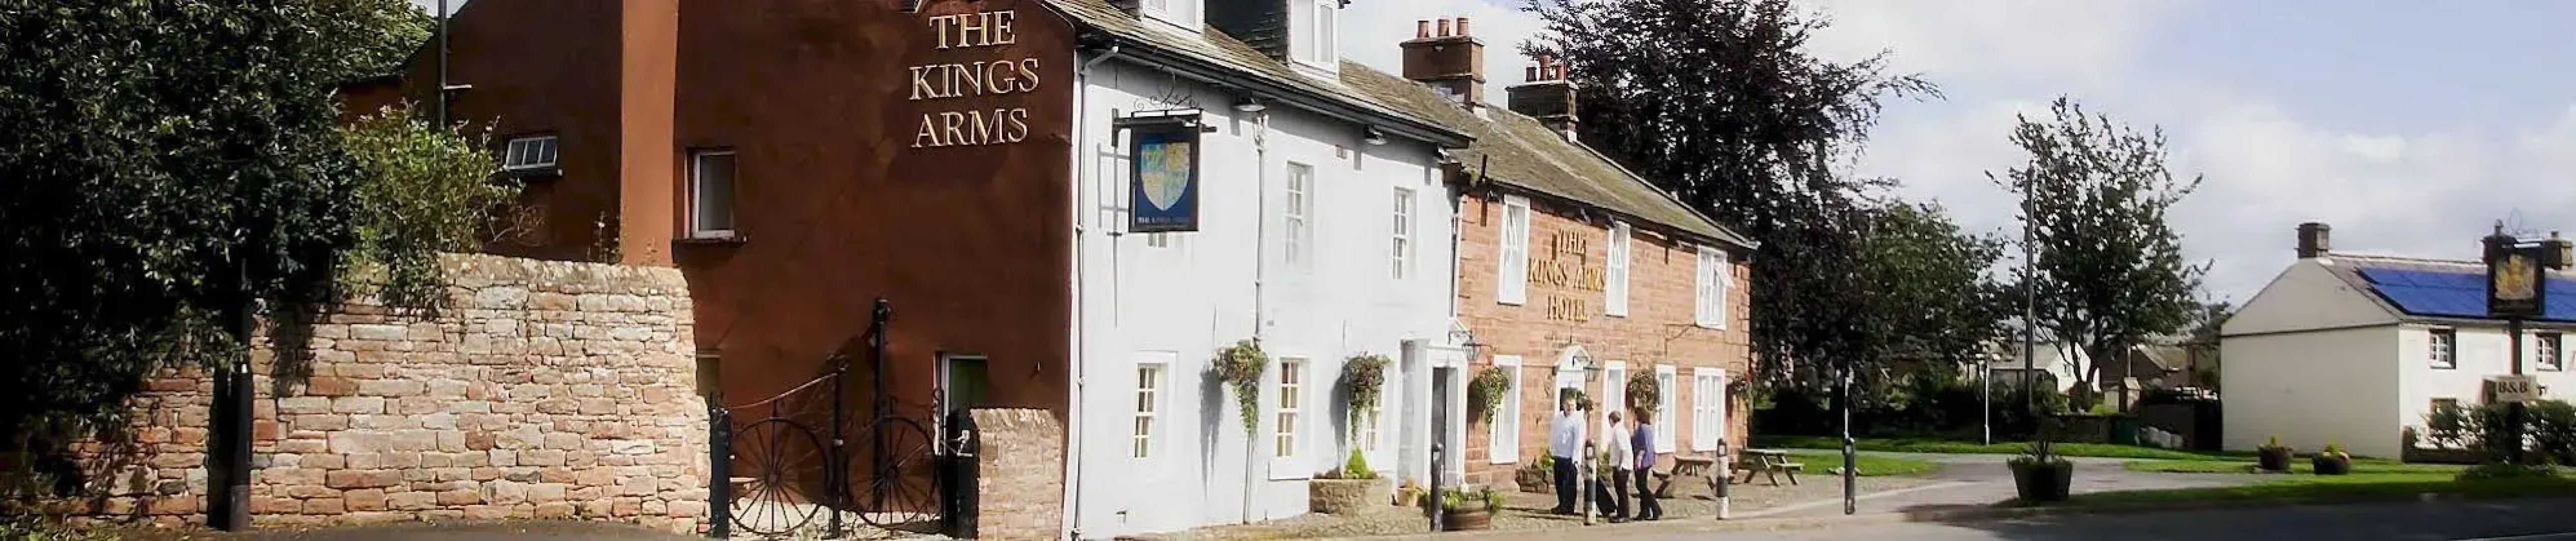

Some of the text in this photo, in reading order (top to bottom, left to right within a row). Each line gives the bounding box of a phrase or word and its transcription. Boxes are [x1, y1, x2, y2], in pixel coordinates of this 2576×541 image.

[929, 10, 1015, 49] THE
[909, 58, 1039, 100] KINGS
[910, 108, 1028, 148] ARMS
[1558, 228, 1586, 255] THE
[1527, 257, 1569, 286] KINGS
[1546, 295, 1590, 322] HOTEL
[2498, 382, 2527, 393] B&B
